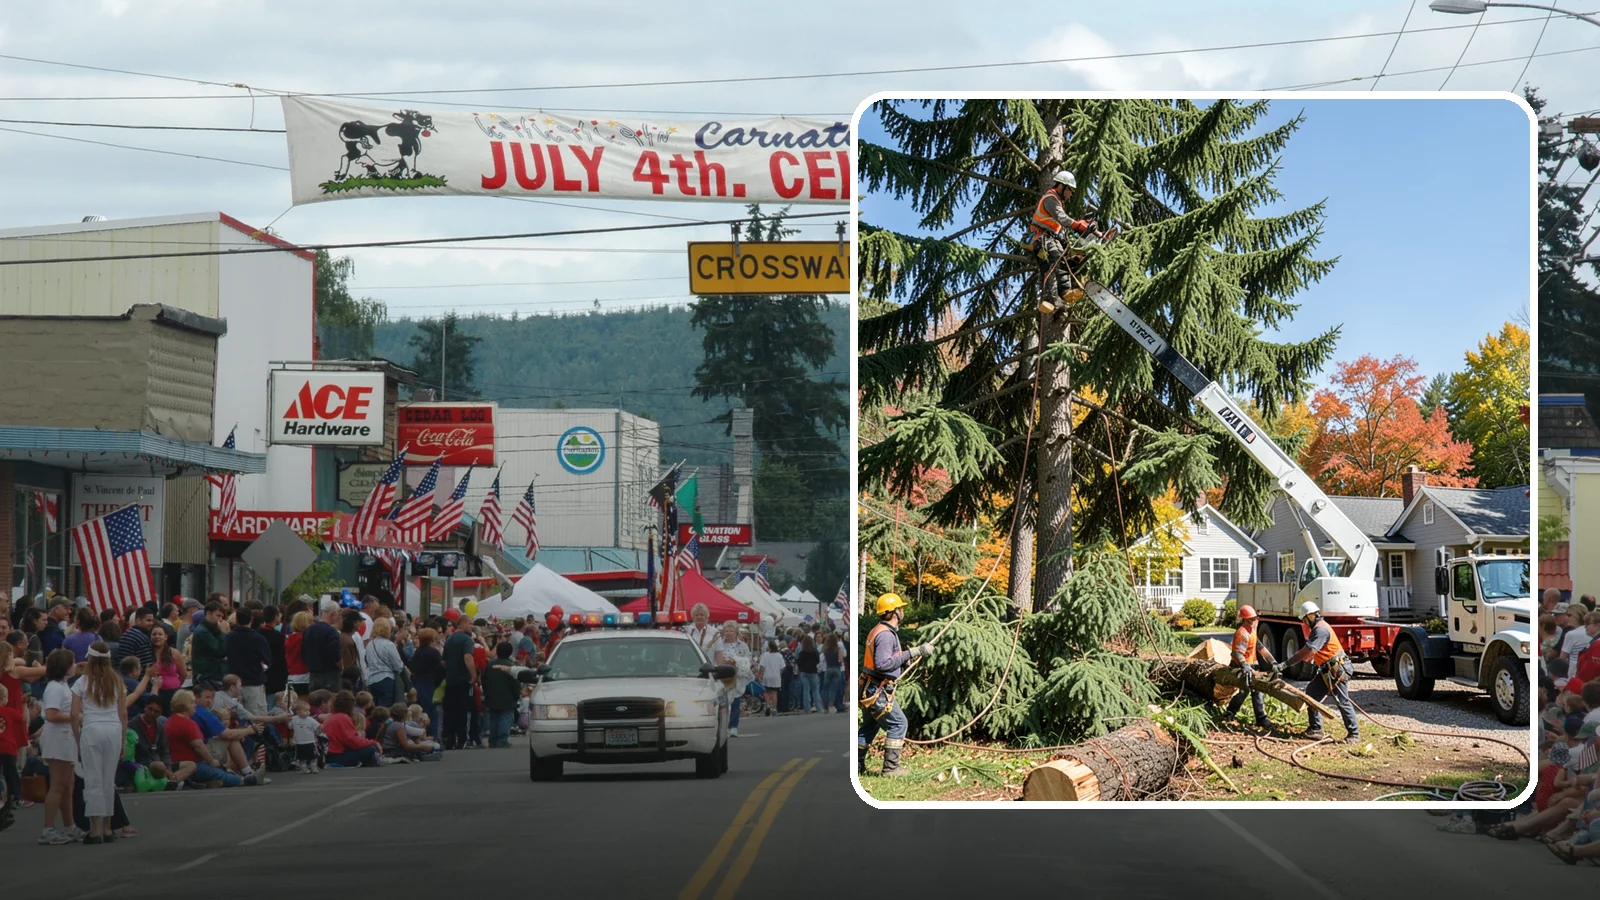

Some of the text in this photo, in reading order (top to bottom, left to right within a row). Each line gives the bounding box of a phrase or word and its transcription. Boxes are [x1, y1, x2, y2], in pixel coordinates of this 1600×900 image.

[695, 121, 850, 150] Carnat
[481, 141, 605, 192] JULY
[632, 150, 747, 198] 4th.
[697, 254, 850, 280] CROSSWA
[282, 380, 374, 420] ACE
[405, 409, 453, 422] CEDAR
[283, 421, 371, 436] Hardware
[416, 428, 477, 447] Coca-Cola
[353, 467, 385, 481] Simpl
[95, 485, 124, 495] Vincent
[126, 486, 136, 495] de
[137, 486, 155, 496] Paul
[212, 515, 331, 536] HARDARE
[688, 526, 741, 535] CRNATION
[699, 535, 730, 543] GLASS
